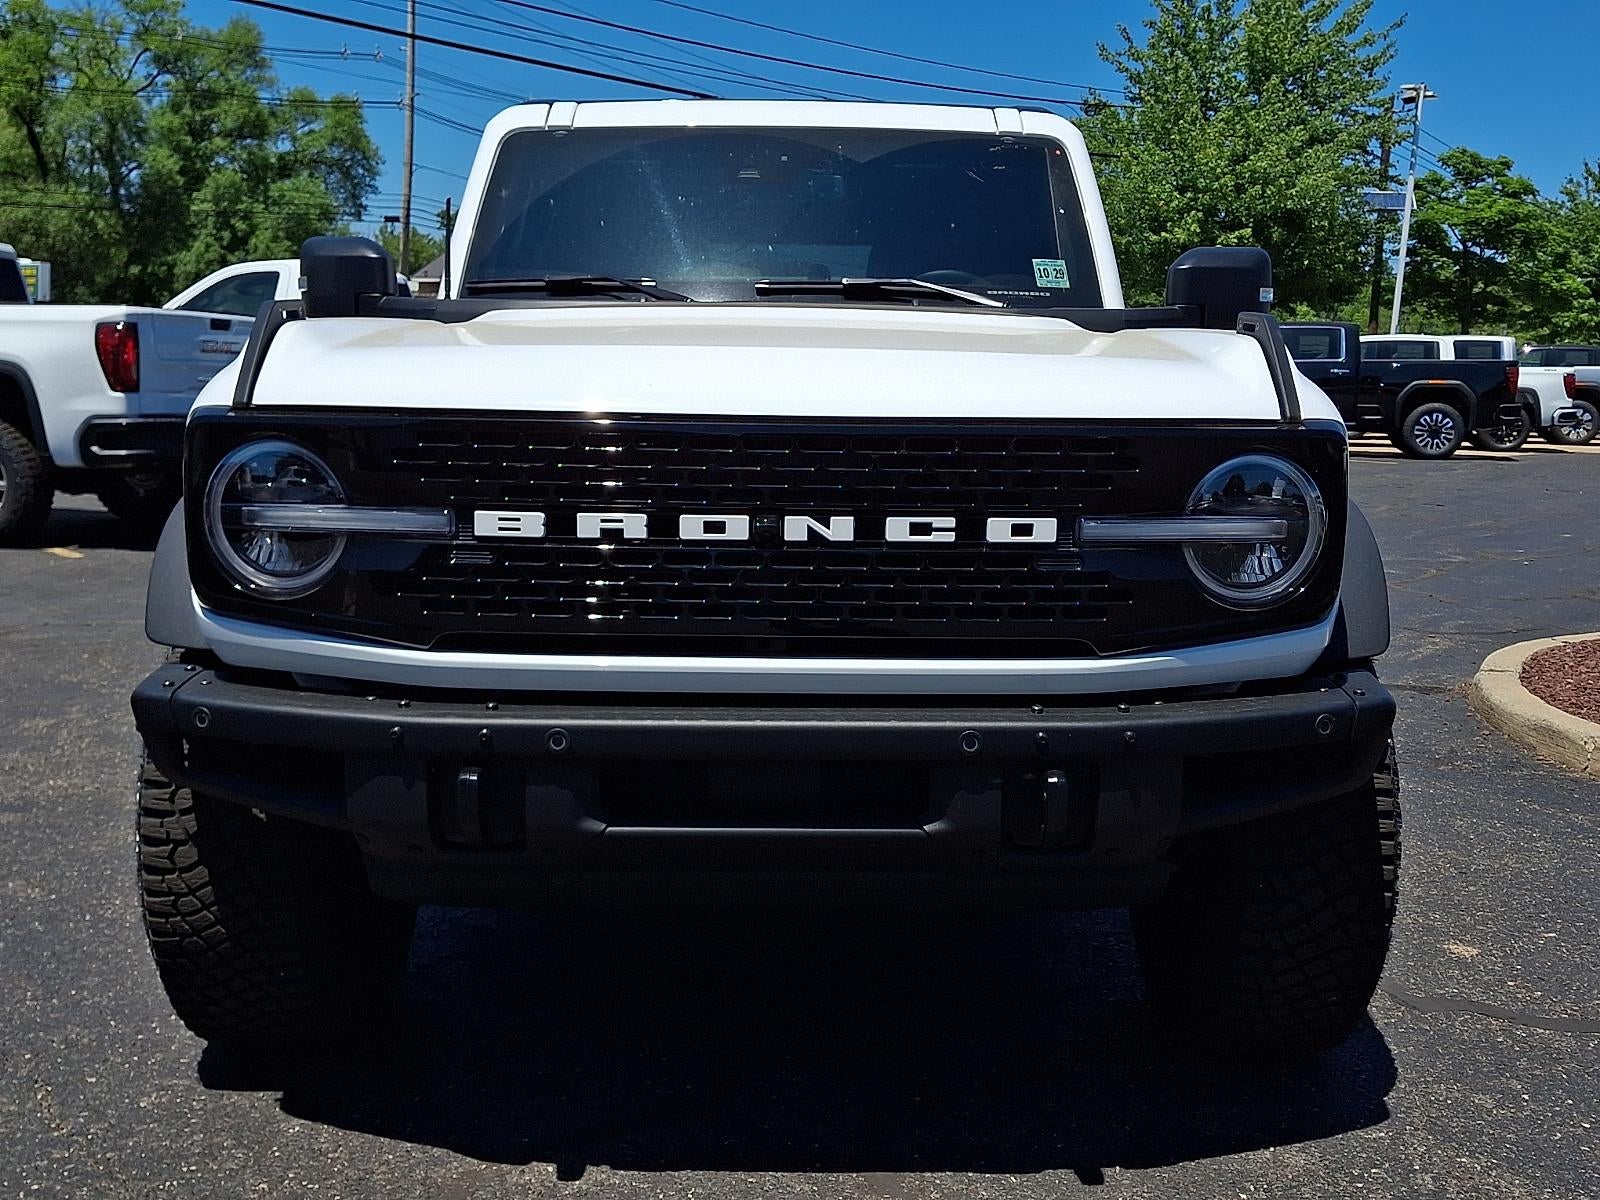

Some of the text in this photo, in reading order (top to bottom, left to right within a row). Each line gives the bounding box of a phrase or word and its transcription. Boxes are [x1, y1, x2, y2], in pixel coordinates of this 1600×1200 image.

[1037, 267, 1065, 280] 10 29
[473, 510, 1058, 543] BRONCO
